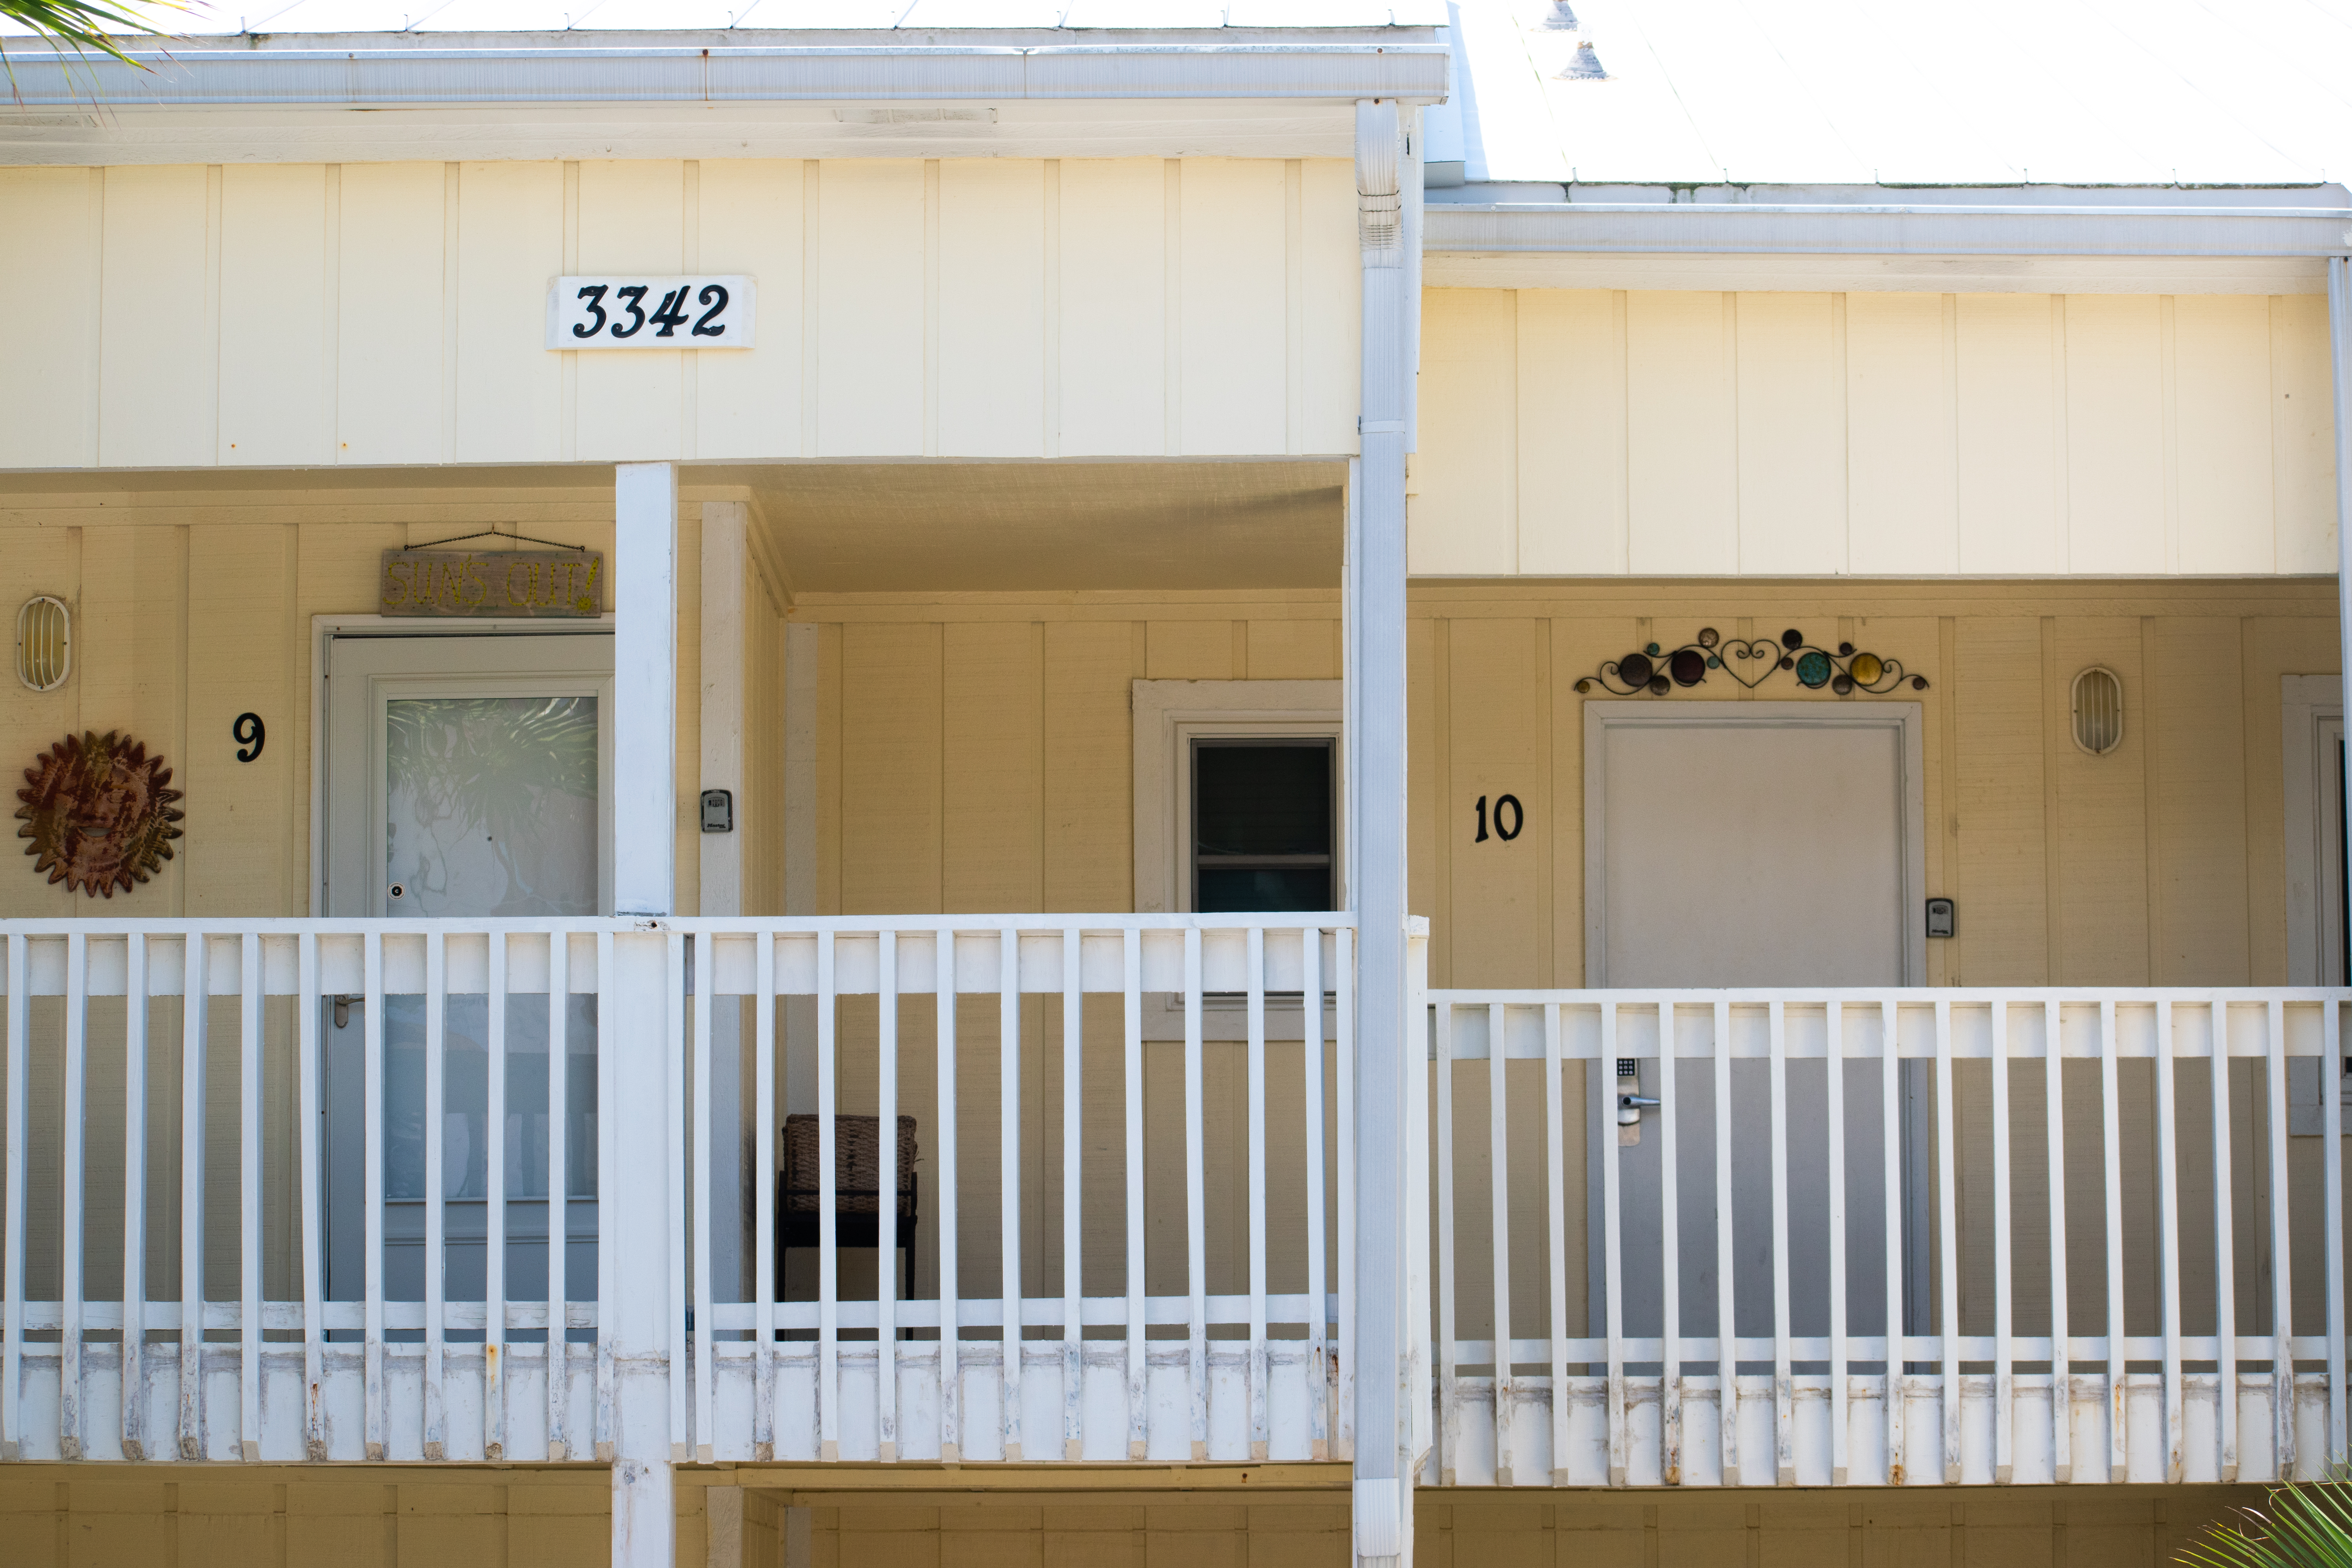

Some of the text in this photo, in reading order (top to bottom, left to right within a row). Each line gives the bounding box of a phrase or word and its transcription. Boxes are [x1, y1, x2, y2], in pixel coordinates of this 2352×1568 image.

[573, 284, 729, 338] 3342
[383, 554, 599, 615] SUN'S OUT!
[233, 712, 265, 763] 9
[1475, 794, 1523, 843] 10
